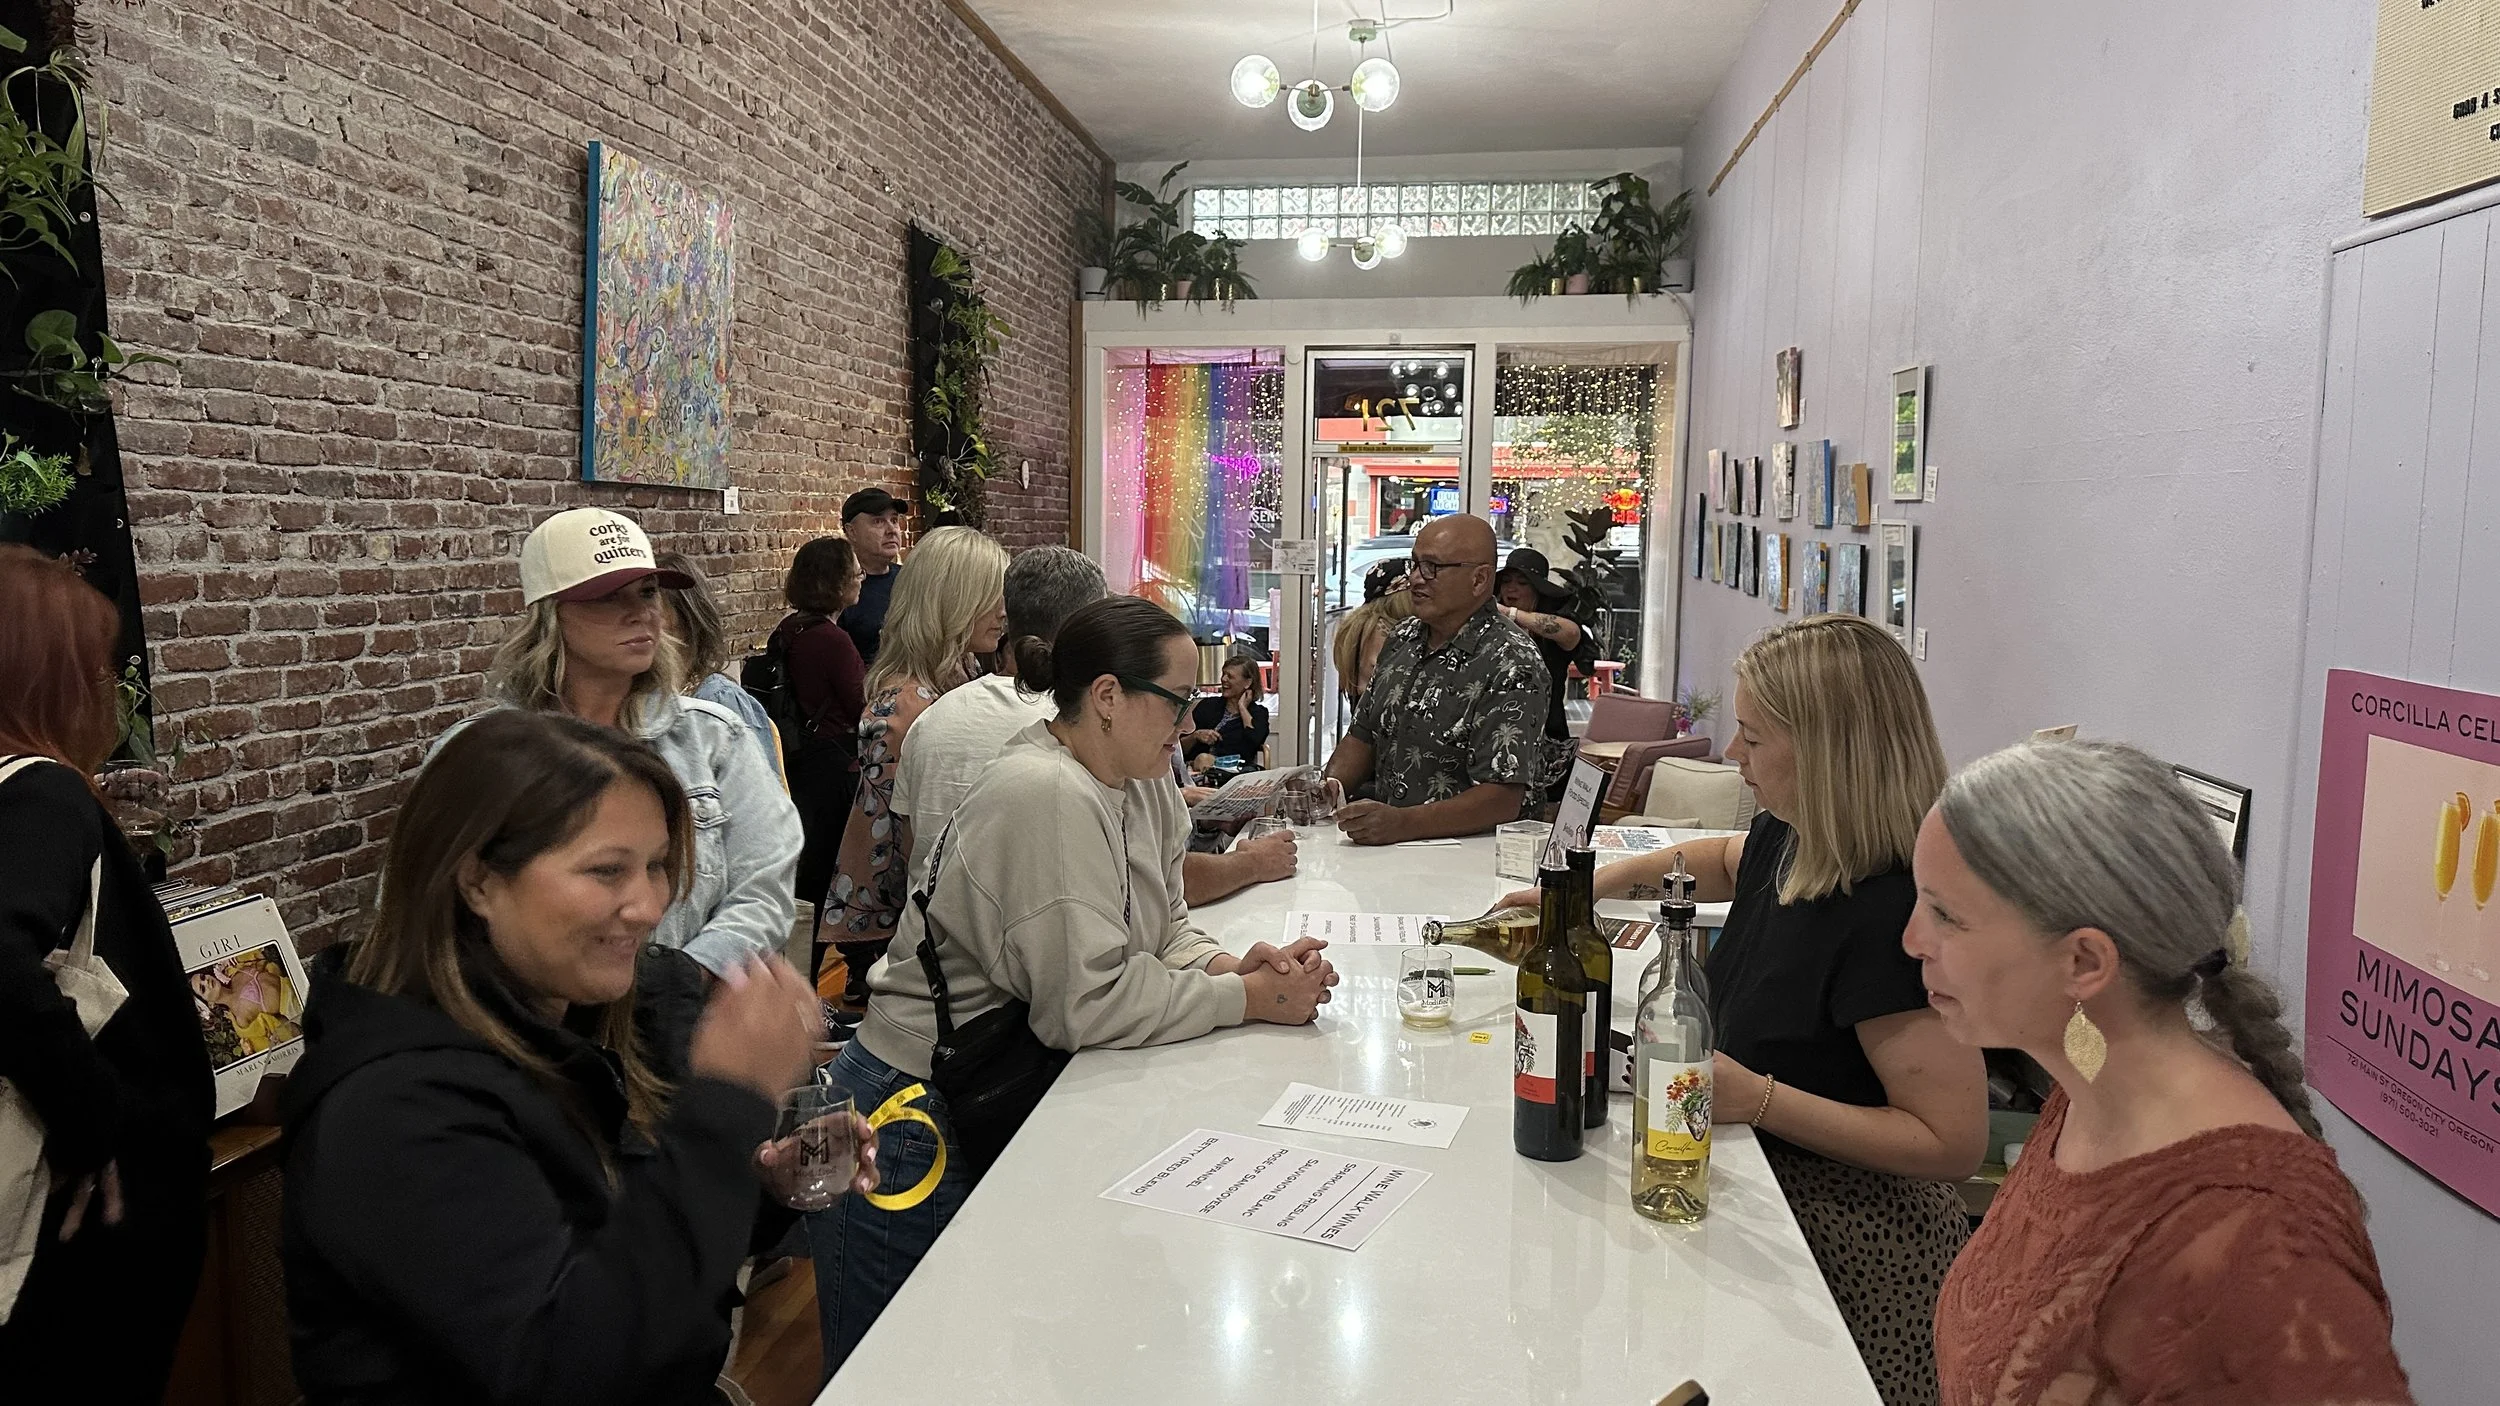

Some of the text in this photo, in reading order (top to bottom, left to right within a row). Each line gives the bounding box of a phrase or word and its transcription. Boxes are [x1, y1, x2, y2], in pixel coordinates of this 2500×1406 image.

[590, 519, 628, 537] corks
[599, 537, 617, 546] are
[2351, 692, 2450, 733] CORCILLA
[2357, 950, 2500, 1052] MIMOSA
[2347, 1053, 2495, 1154] 721 MAIN ST OREGON CITY OREGON
[2380, 1091, 2440, 1138] (971) 500-3021
[1130, 1137, 1219, 1196] BETTY (RED BLEND)
[1186, 1156, 1235, 1188] ZINFANDEL
[1242, 1158, 1319, 1218] SAUVIGNON BLANC
[1253, 1165, 1266, 1176] OF
[1199, 1173, 1256, 1214] SANGIOVESE
[1276, 1162, 1357, 1228] SPARKLING RIESLING
[1320, 1169, 1406, 1240] WINE WALK WINES
